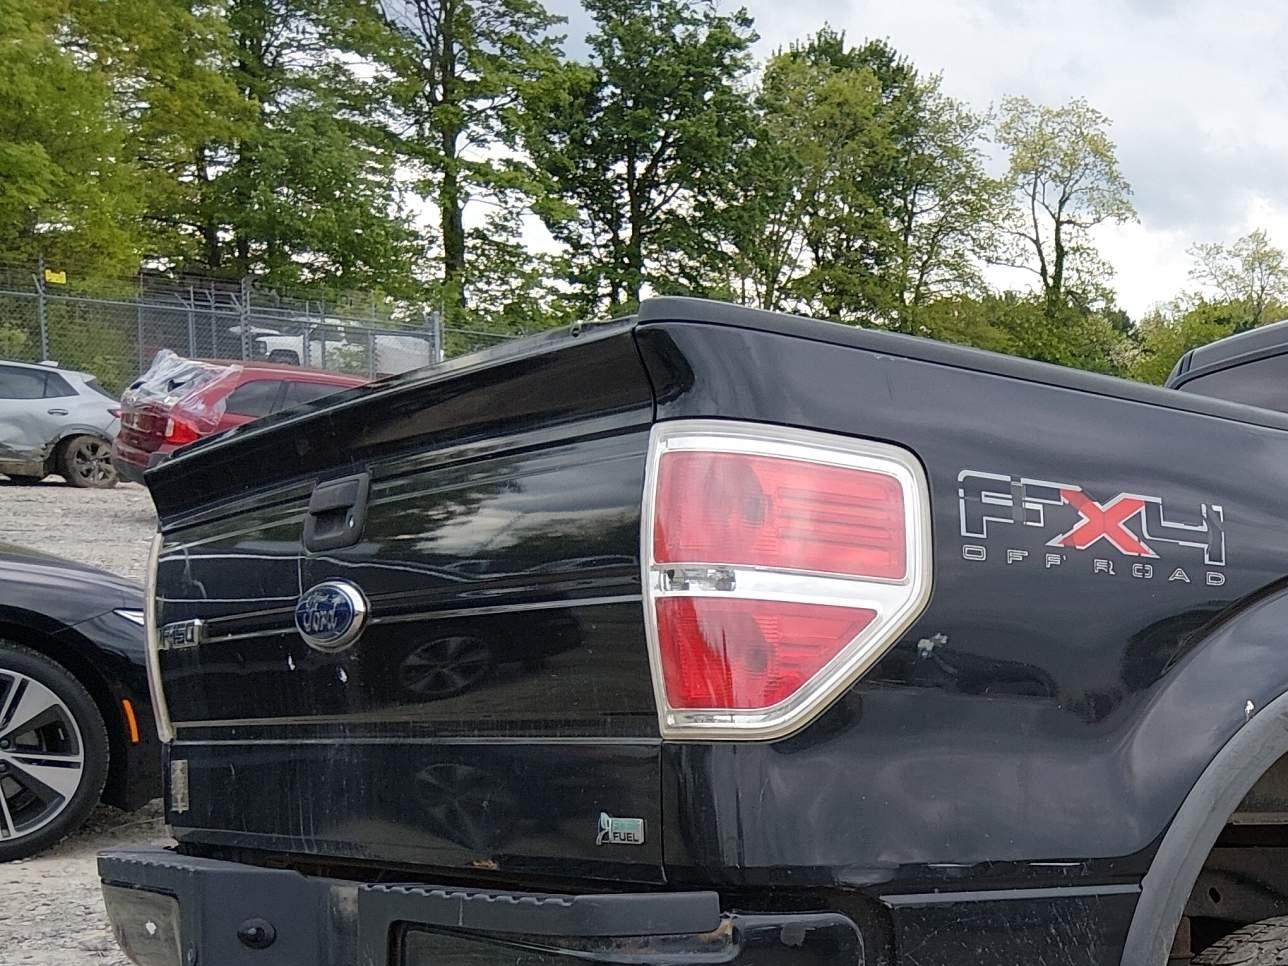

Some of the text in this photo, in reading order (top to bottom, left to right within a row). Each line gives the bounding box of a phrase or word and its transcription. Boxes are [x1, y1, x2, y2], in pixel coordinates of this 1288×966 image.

[957, 469, 1227, 566] FX4
[962, 544, 1226, 586] OFF ROAD
[302, 594, 342, 632] Ford
[612, 831, 640, 842] FUEL
